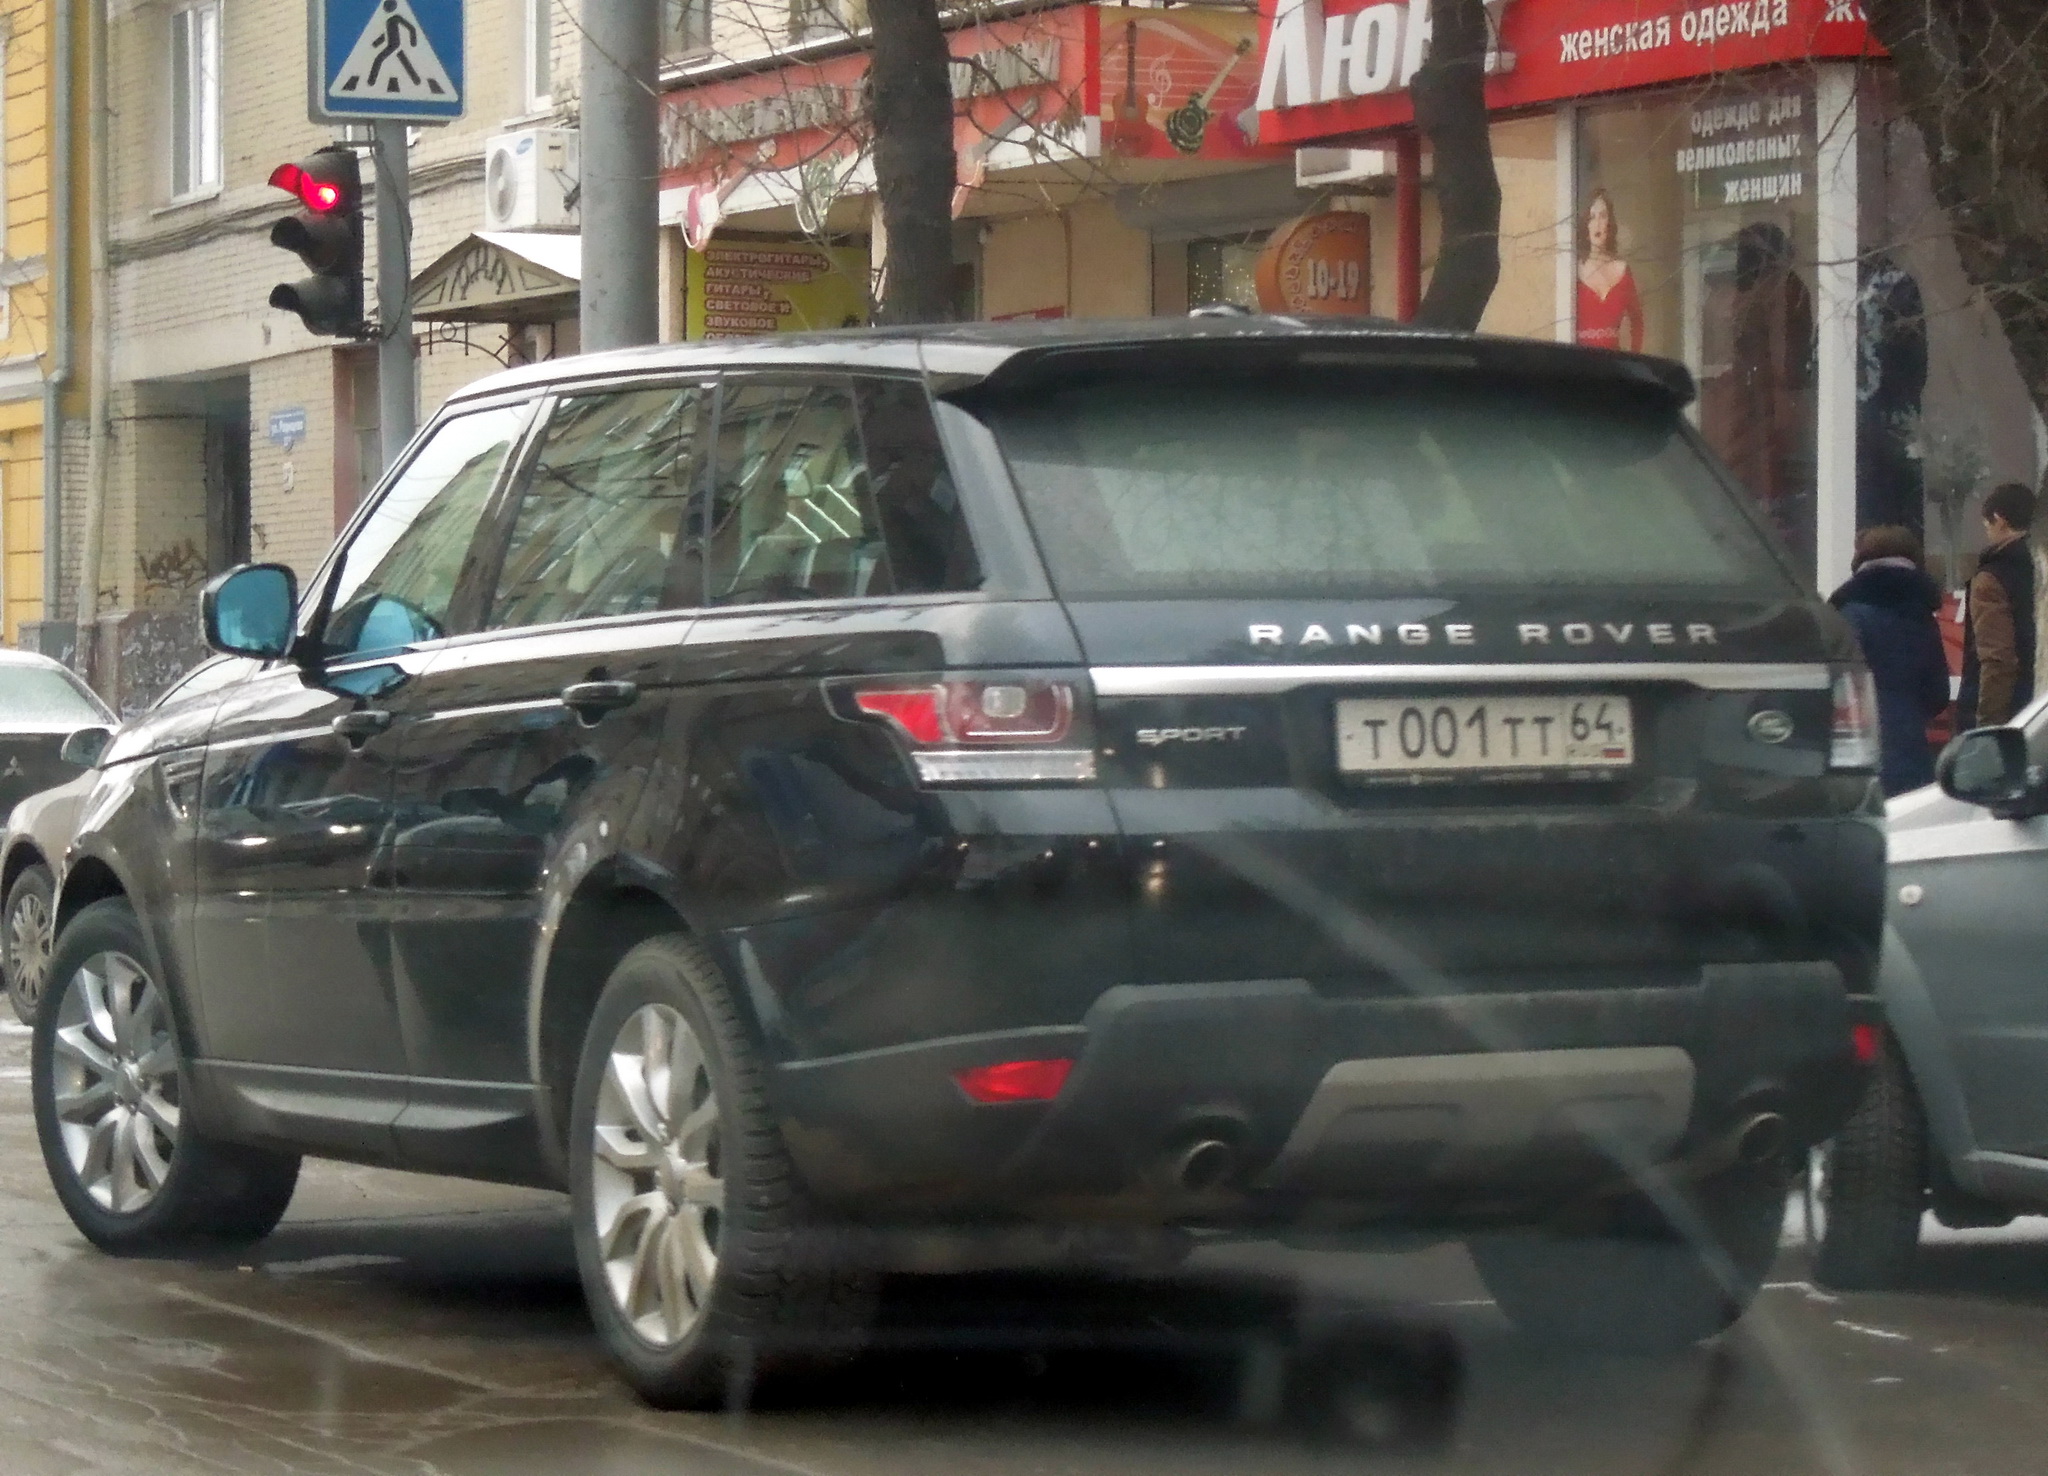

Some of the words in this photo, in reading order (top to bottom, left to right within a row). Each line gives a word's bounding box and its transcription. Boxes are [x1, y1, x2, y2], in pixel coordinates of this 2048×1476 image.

[1560, 15, 1671, 63] женская
[1680, 0, 1789, 46] одежда
[1691, 100, 1761, 138] одежда
[1767, 94, 1801, 127] для
[1676, 133, 1802, 173] великолепных
[1724, 172, 1802, 204] женщин
[706, 300, 776, 313] СВЕТОВОЕ
[706, 316, 775, 330] ЗВУКОВОЕ
[1248, 623, 1477, 646] RANGE
[1518, 623, 1719, 645] ROVER
[1136, 726, 1248, 747] SPORT
